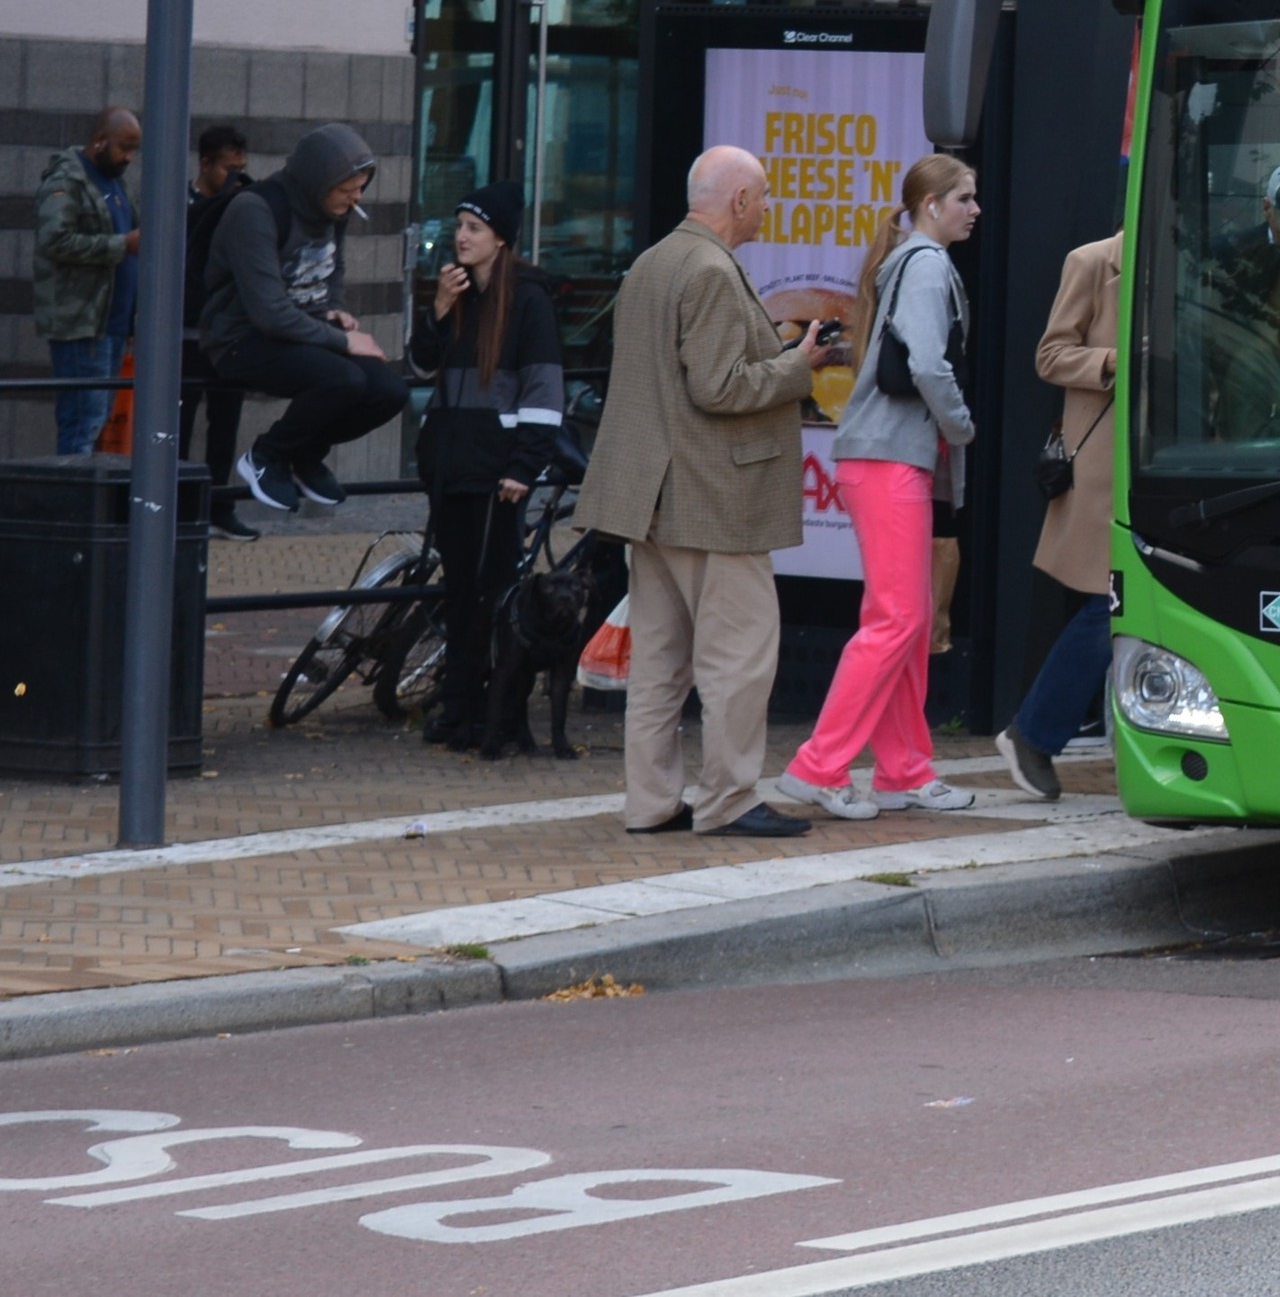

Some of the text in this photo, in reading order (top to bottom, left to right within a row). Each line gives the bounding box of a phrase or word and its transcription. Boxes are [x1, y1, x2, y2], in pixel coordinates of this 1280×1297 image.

[818, 33, 853, 43] Channel
[765, 111, 877, 157] FRISCO
[758, 157, 855, 201] HEESE
